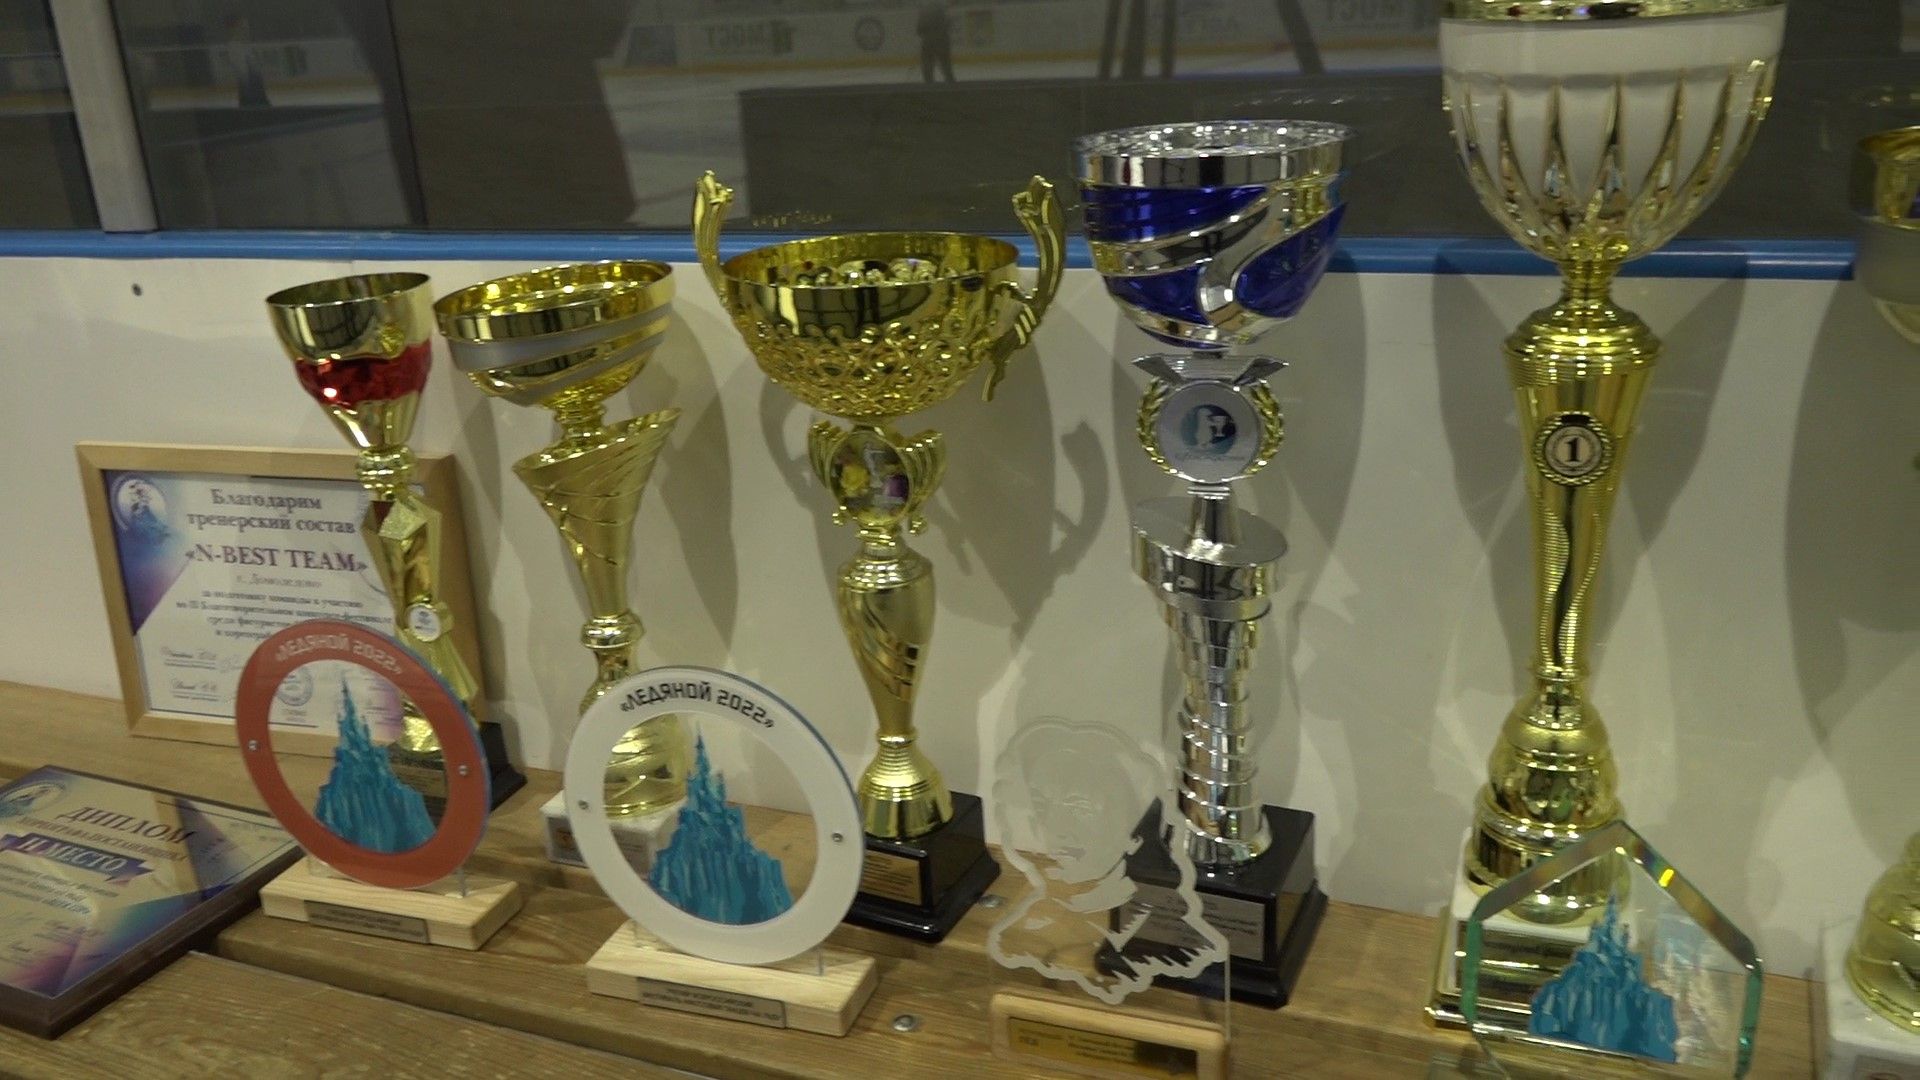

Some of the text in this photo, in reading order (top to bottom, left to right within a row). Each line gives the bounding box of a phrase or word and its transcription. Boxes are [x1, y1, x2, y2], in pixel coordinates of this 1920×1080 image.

[1564, 437, 1580, 462] 1
[210, 488, 322, 514] Благодарим
[186, 512, 355, 534] тренерский состав
[620, 680, 774, 728] «ЛЕДЯНОЙ 2022»
[56, 806, 197, 844] ДИПЛОМ
[43, 842, 127, 872] МЕСТО
